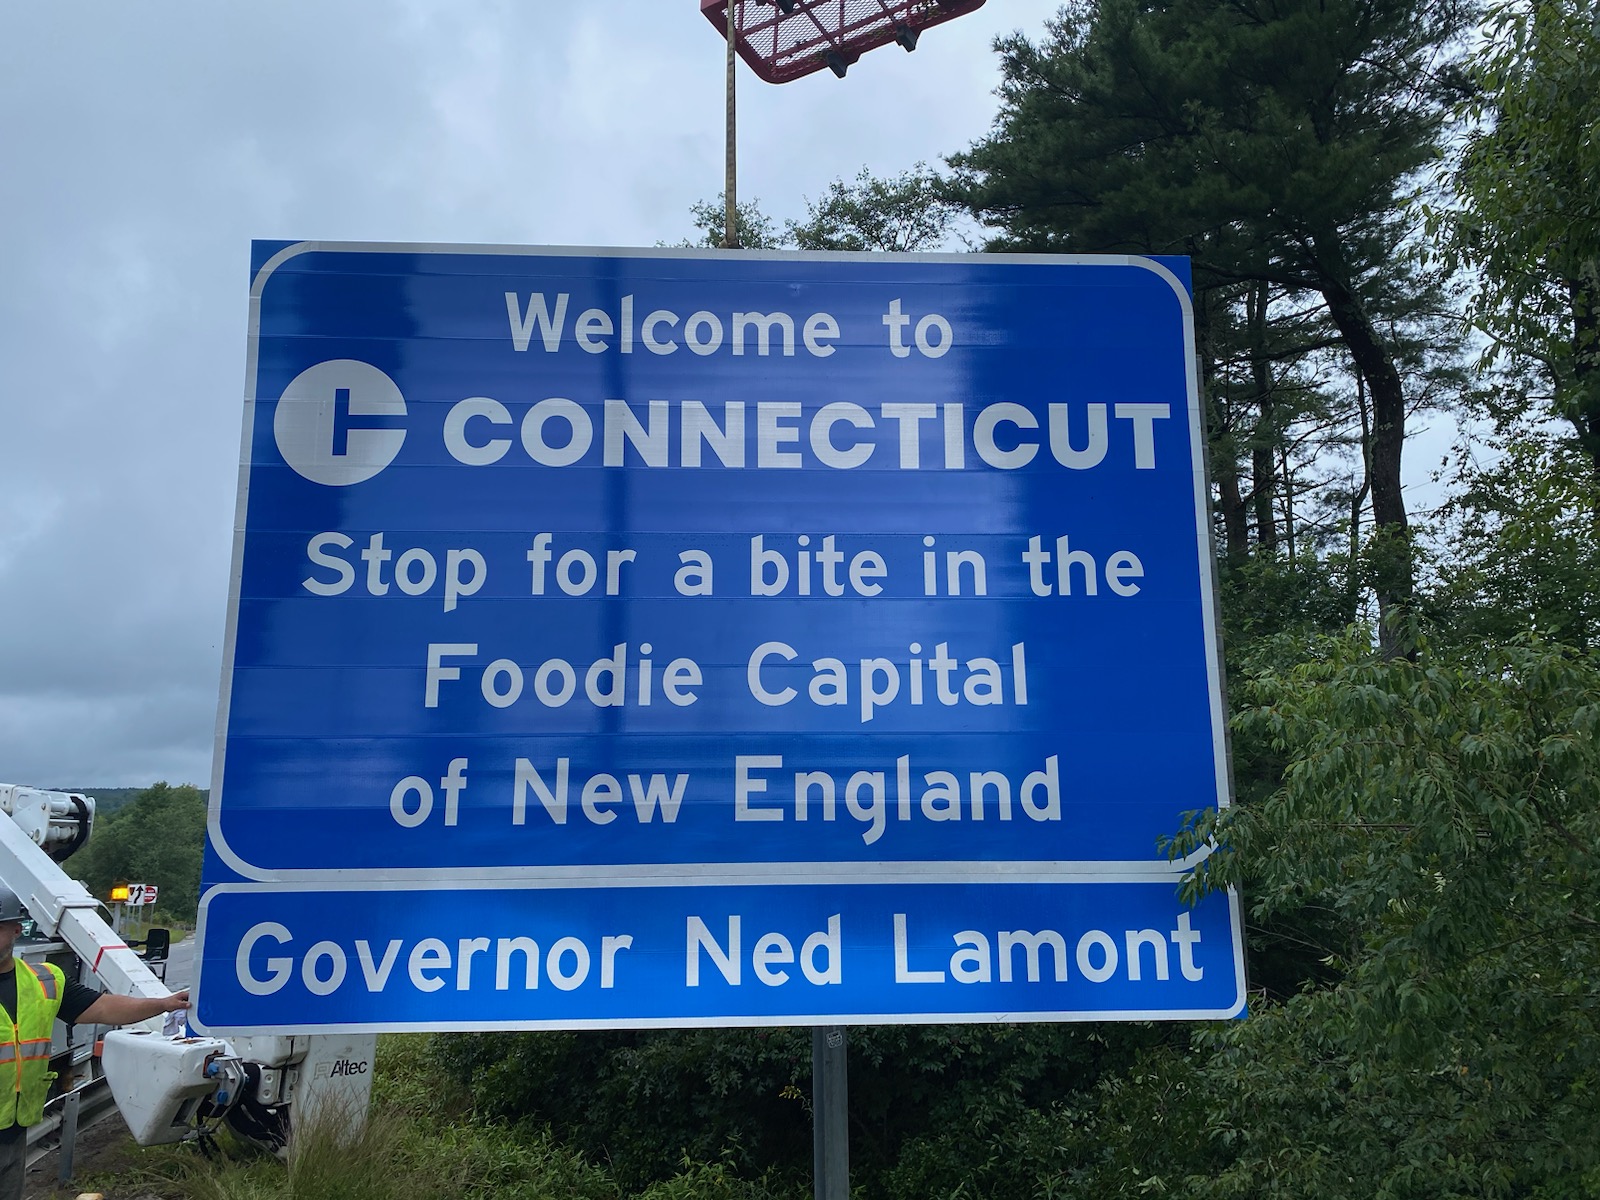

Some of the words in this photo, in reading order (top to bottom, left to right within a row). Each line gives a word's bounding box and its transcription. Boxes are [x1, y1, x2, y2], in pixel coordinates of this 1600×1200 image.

[504, 292, 841, 358] Welcome
[882, 298, 954, 359] to
[443, 397, 1171, 470] CONNECTICUT
[301, 531, 487, 613] Stop
[526, 532, 637, 597] for
[673, 549, 713, 597] a
[750, 534, 888, 597] bite
[923, 535, 987, 597] in
[1022, 534, 1145, 597] the
[424, 642, 703, 708] Foodie
[747, 641, 1028, 723] Capital
[389, 757, 468, 828] of
[512, 757, 689, 825] New
[735, 754, 1062, 845] England
[235, 921, 634, 996] Governor
[686, 913, 842, 988] Ned
[893, 911, 1205, 985] Lamont
[330, 1060, 368, 1078] Altec
